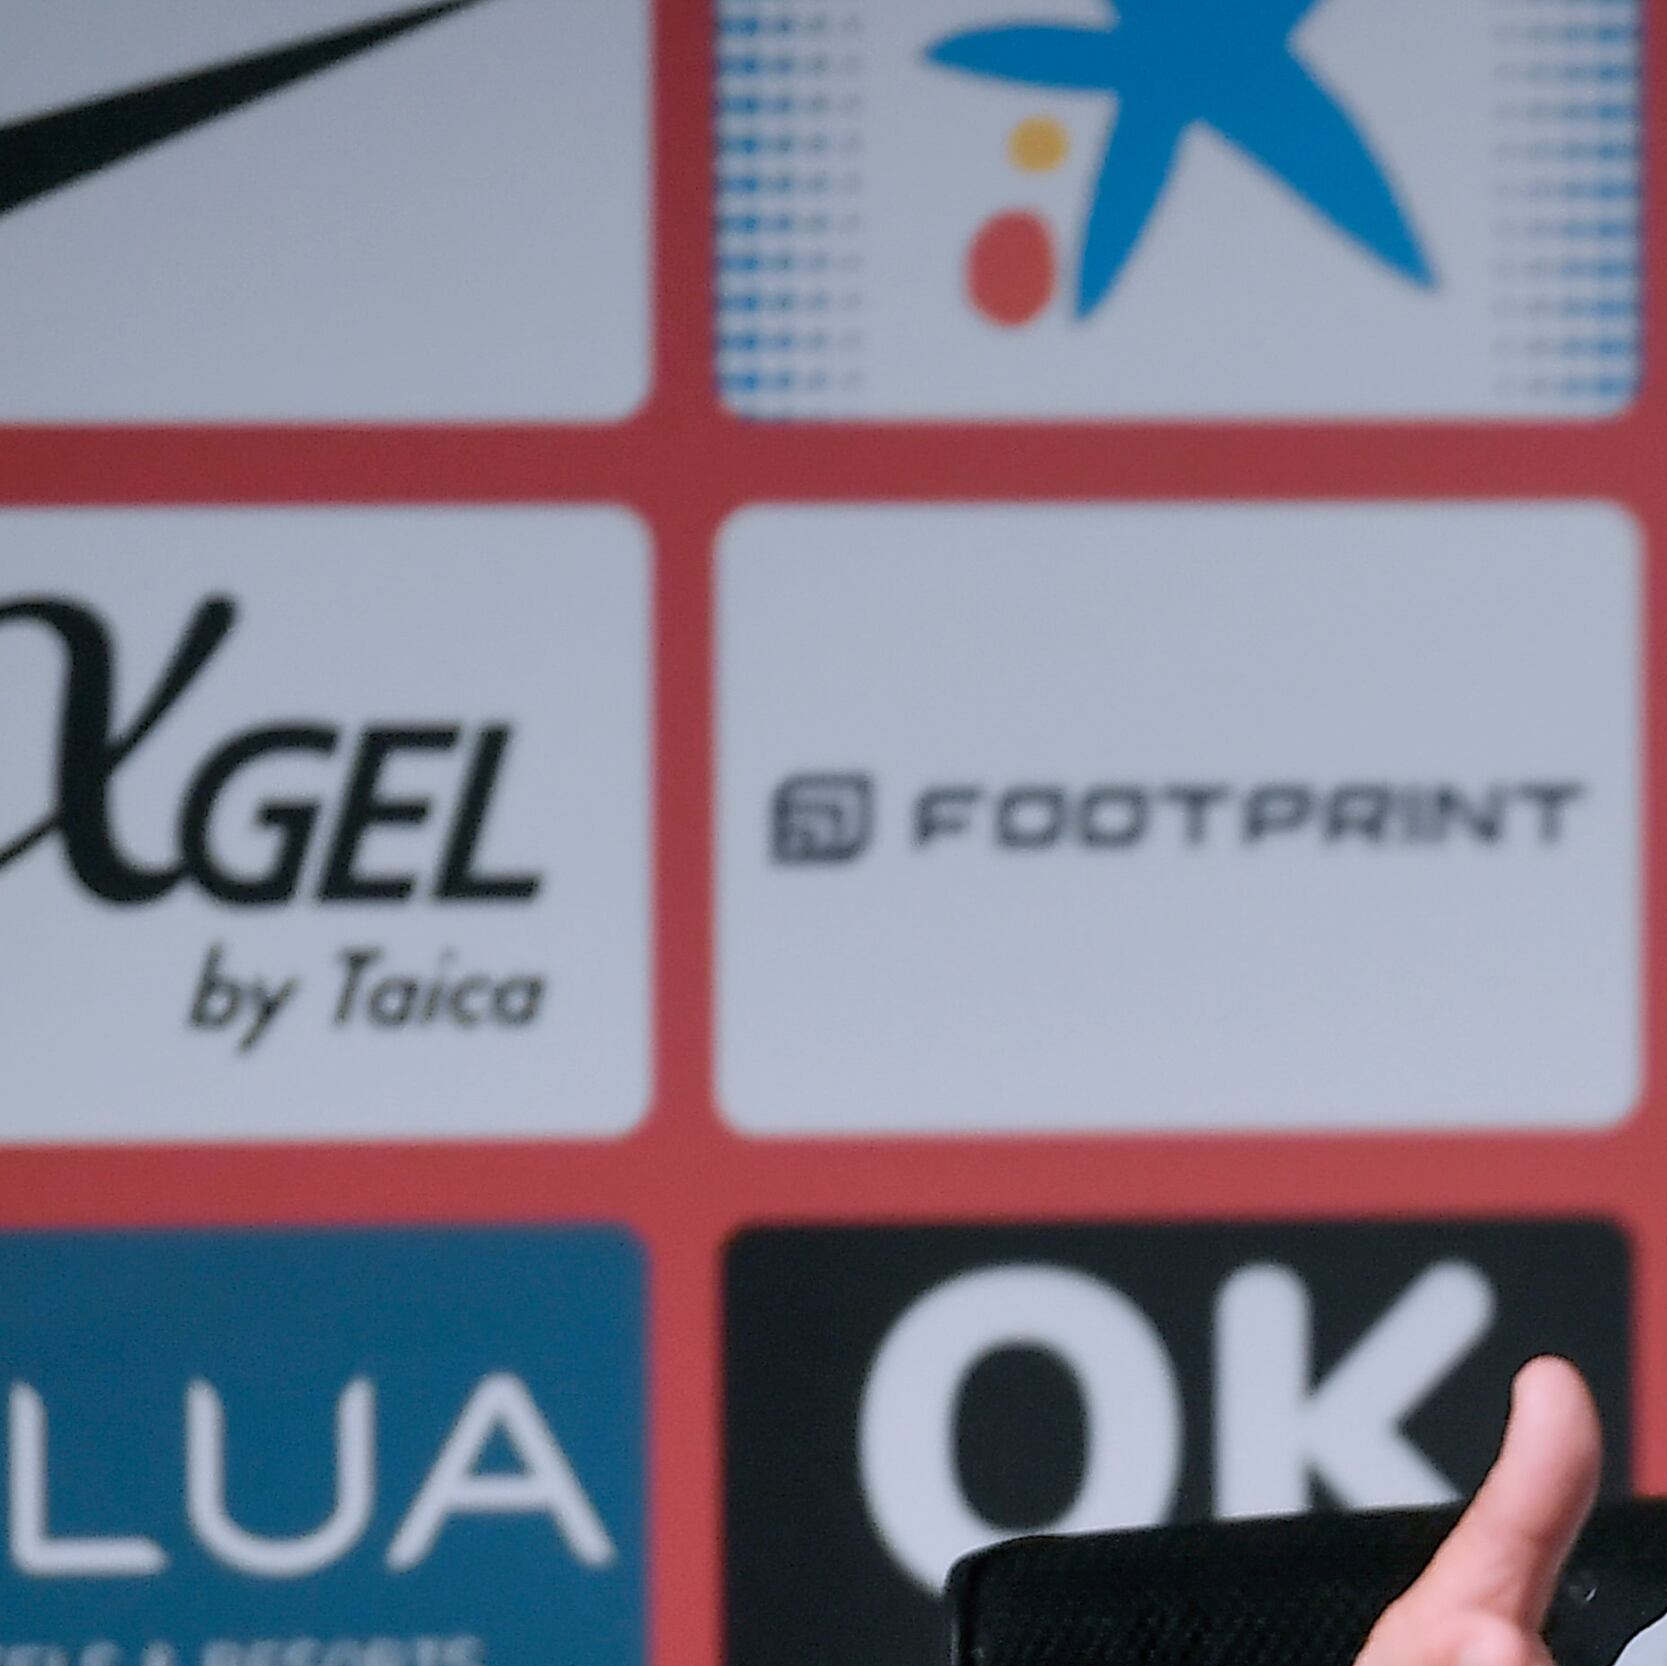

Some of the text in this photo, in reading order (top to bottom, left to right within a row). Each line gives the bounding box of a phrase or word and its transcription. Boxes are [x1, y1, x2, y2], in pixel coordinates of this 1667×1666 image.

[912, 783, 1586, 850] FOOTPRINT
[187, 945, 546, 1055] by Taica
[9, 1370, 616, 1576] LUA
